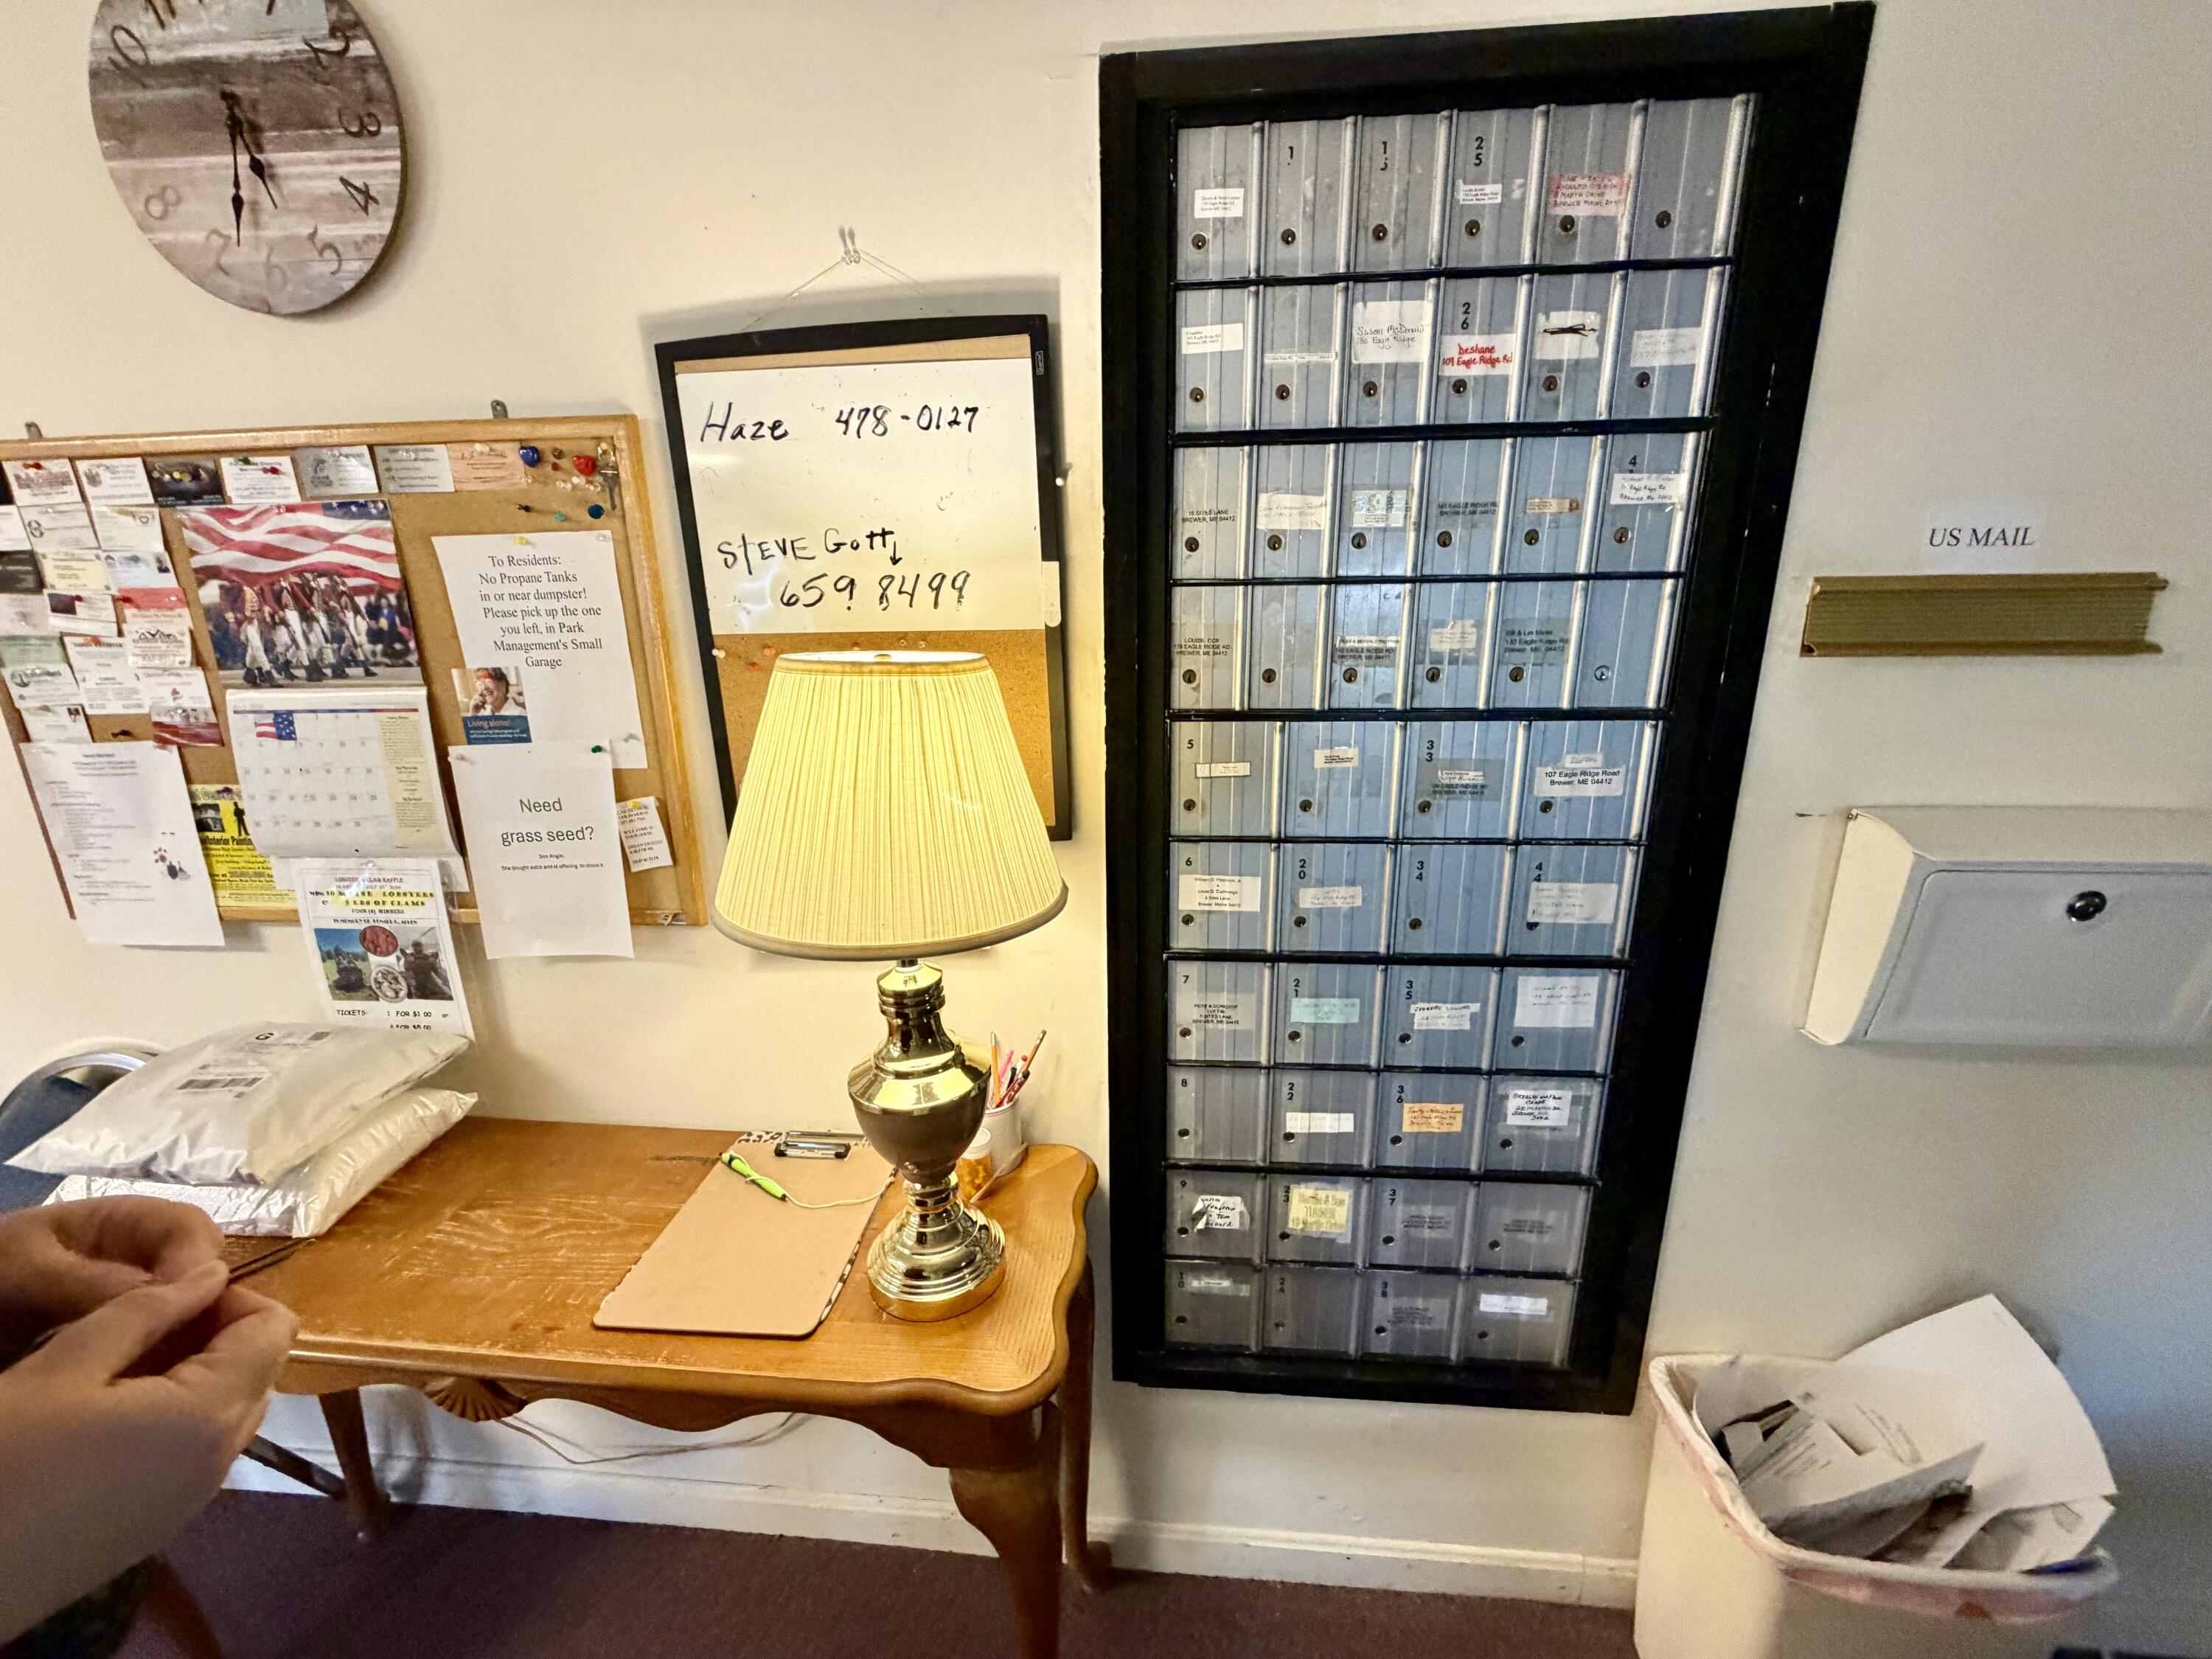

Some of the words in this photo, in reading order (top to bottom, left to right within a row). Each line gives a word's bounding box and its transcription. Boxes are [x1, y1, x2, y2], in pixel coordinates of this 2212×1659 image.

[303, 25, 350, 69] 2
[338, 107, 380, 138] 3
[144, 185, 183, 220] 8
[340, 176, 379, 215] 4
[206, 228, 232, 276] 7
[308, 225, 342, 275] 5
[265, 246, 287, 291] 6
[1458, 343, 1495, 355] Deshane
[1443, 358, 1454, 366] 109
[1457, 357, 1478, 369] Eagle
[1479, 355, 1501, 368] Ridge
[1503, 352, 1512, 363] Rd
[700, 400, 789, 442] Haze
[1929, 526, 1961, 547] US
[1966, 526, 2035, 547] MAIL
[488, 556, 505, 567] To
[507, 554, 561, 567] Residents:
[479, 573, 497, 585] No
[499, 572, 542, 587] Propane
[544, 571, 577, 583] Tanks
[480, 591, 491, 602] in
[494, 593, 504, 601] or
[507, 591, 531, 601] near
[533, 588, 587, 603] dumpster!
[780, 574, 856, 611] 659
[878, 570, 971, 611] 8499
[484, 607, 518, 619] Please
[520, 606, 543, 621] pick
[545, 608, 558, 619] up
[561, 605, 578, 617] the
[581, 607, 602, 616] one
[500, 625, 521, 637] you
[523, 622, 543, 636] left,
[545, 623, 556, 634] in
[558, 621, 585, 633] Park
[494, 639, 568, 654] Management's
[571, 639, 603, 650] Small
[525, 655, 563, 670] Garage
[1187, 740, 1194, 749] 5
[519, 797, 563, 813] Need
[501, 829, 543, 846] grass
[547, 826, 595, 841] seed?
[1186, 858, 1192, 866] 6
[1183, 975, 1189, 984] 7
[1181, 1079, 1187, 1087] 8
